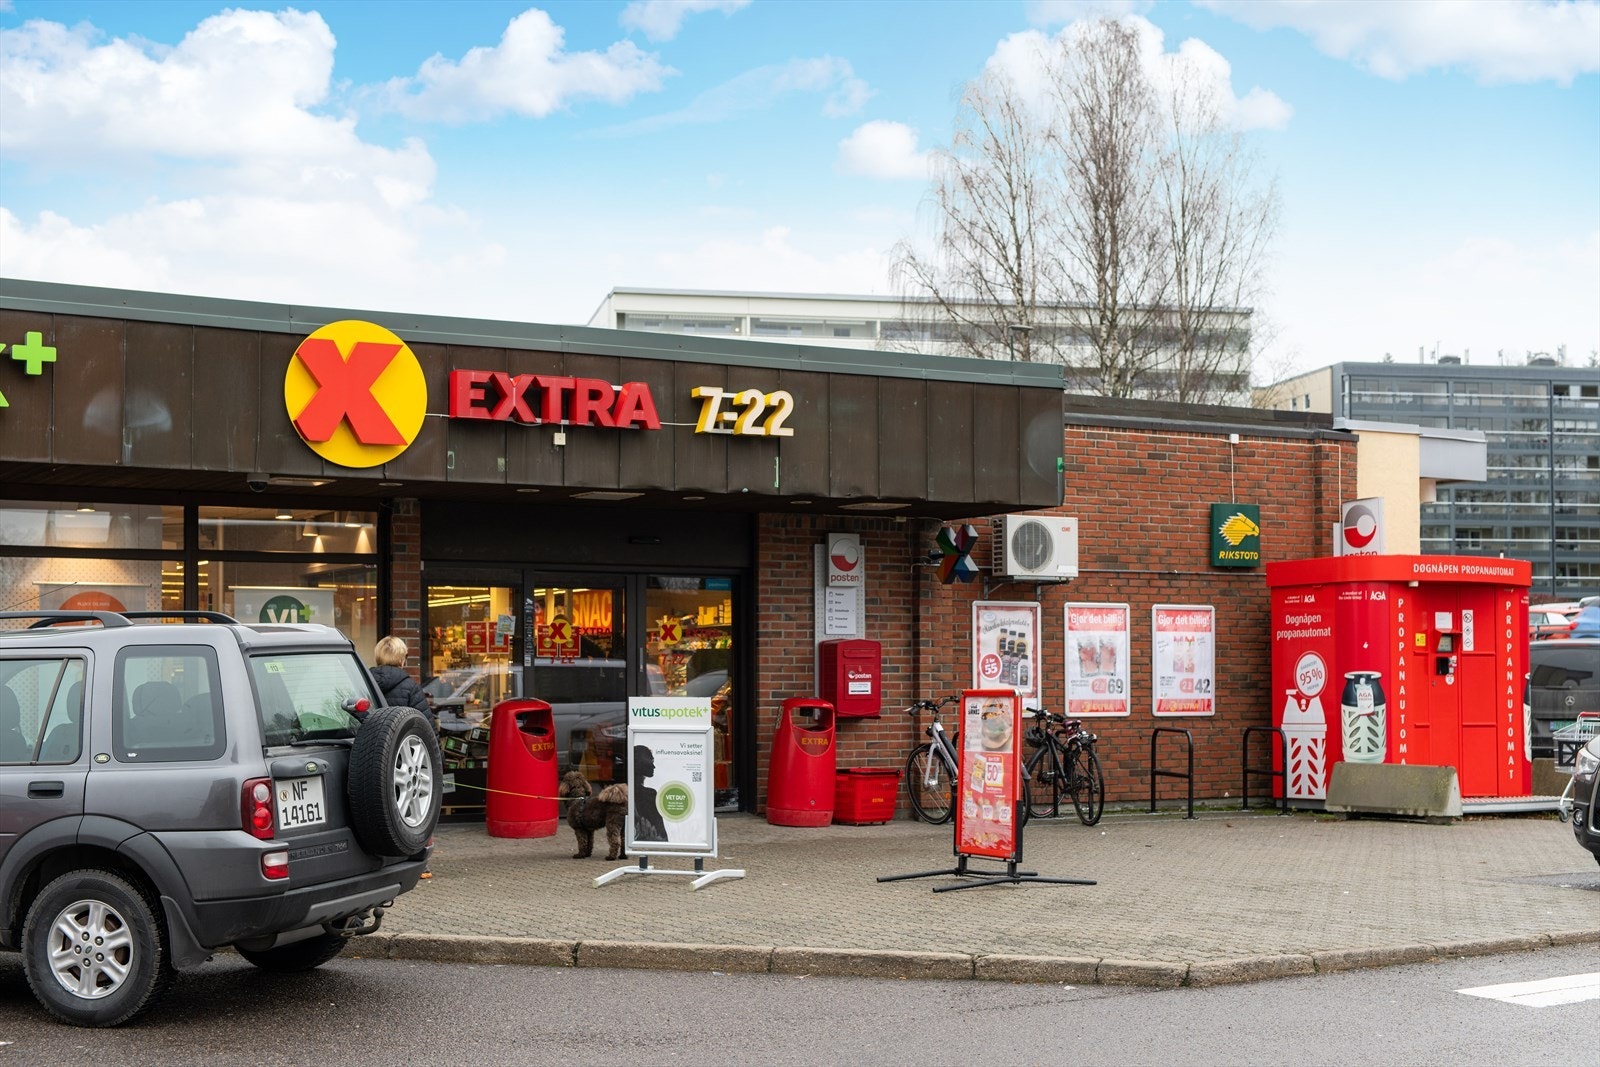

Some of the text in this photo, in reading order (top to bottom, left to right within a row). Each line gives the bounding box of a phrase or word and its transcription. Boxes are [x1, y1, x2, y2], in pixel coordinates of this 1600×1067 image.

[450, 369, 794, 437] EXTRA 7-22
[1219, 551, 1259, 560] RIKSTOTO
[1413, 563, 1514, 576] DØGNÅPEN PROPANAUTOMAT
[830, 574, 859, 583] posten
[1304, 595, 1315, 603] AGA
[1369, 590, 1386, 600] AGA
[1071, 613, 1124, 626] Gjør det billig!
[1158, 614, 1209, 627] Gjør det billig!
[1286, 614, 1321, 626] Døgnåpen
[577, 627, 612, 636] EXTRA
[685, 629, 719, 637] EXTRA
[1277, 627, 1331, 640] propanautomat
[550, 654, 575, 664] 7-22
[660, 654, 685, 664] 7-22
[984, 663, 998, 675] 55
[1108, 678, 1124, 694] 69
[1195, 678, 1211, 694] 42
[1505, 601, 1514, 779] PROPANAUTOMAT
[532, 743, 554, 751] EXTRA
[801, 737, 828, 745] EXTRA
[292, 781, 308, 801] NF
[282, 802, 322, 826] 14161
